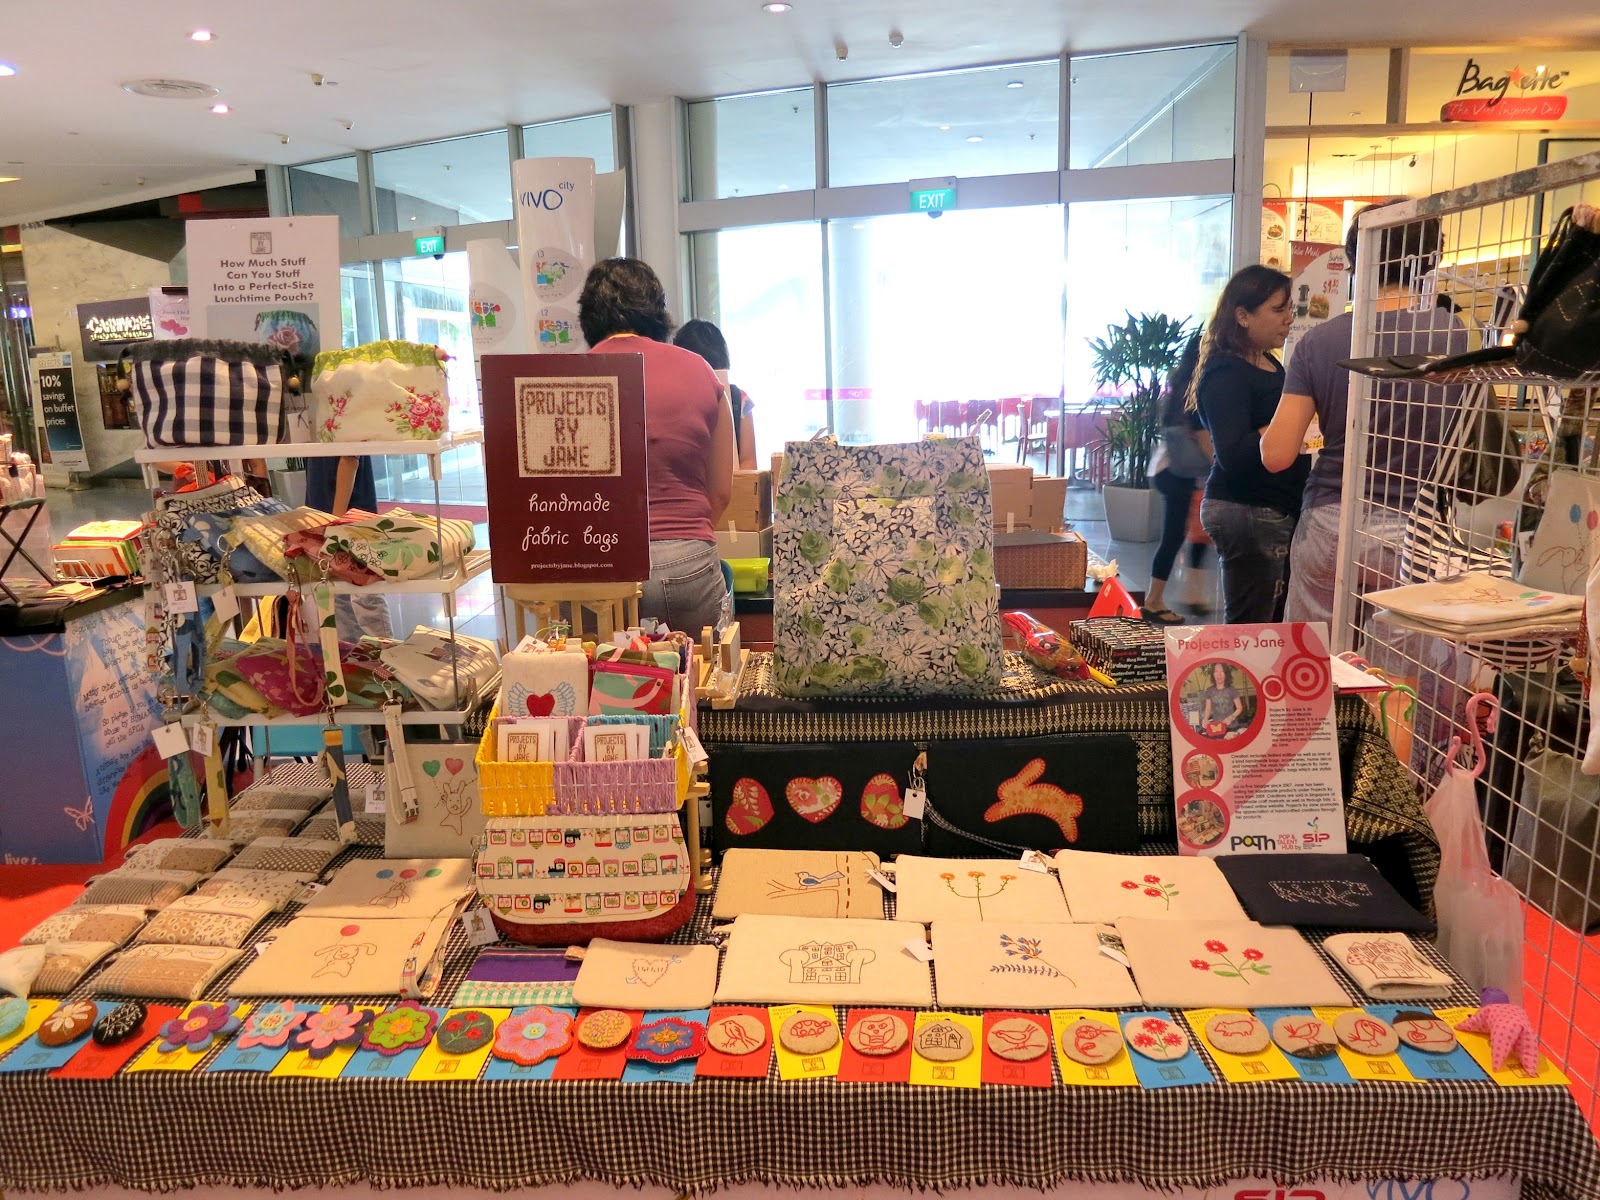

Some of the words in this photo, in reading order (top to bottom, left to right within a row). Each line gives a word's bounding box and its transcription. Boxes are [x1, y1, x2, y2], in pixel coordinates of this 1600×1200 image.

[558, 181, 575, 191] city
[919, 193, 945, 209] EXIT
[420, 239, 437, 253] EXIT
[220, 260, 245, 268] How
[248, 258, 277, 267] Much
[281, 257, 306, 266] Stuff
[226, 271, 248, 279] Can
[251, 270, 272, 279] You
[275, 269, 301, 278] Stuff
[213, 283, 235, 291] Into
[249, 281, 314, 291] Perfect-Size
[214, 293, 271, 303] Lunchtime
[275, 292, 314, 301] Pouch?
[41, 375, 62, 388] 10%
[42, 392, 65, 402] savings
[54, 403, 75, 412] buffet
[525, 391, 607, 415] PROJECTS
[46, 418, 66, 428] prices
[554, 417, 579, 444] BY
[543, 446, 590, 468] JANE
[529, 493, 610, 512] handmade
[522, 525, 570, 552] fabric
[583, 525, 619, 552] bags
[1178, 638, 1230, 652] Projects
[1234, 638, 1249, 651] By
[1254, 637, 1286, 648] Jane
[509, 736, 537, 744] PROJECTS
[596, 735, 624, 744] PROJECTS
[518, 744, 527, 753] BY
[606, 745, 615, 753] BY
[513, 753, 530, 761] JANE
[4, 853, 42, 865] lives.
